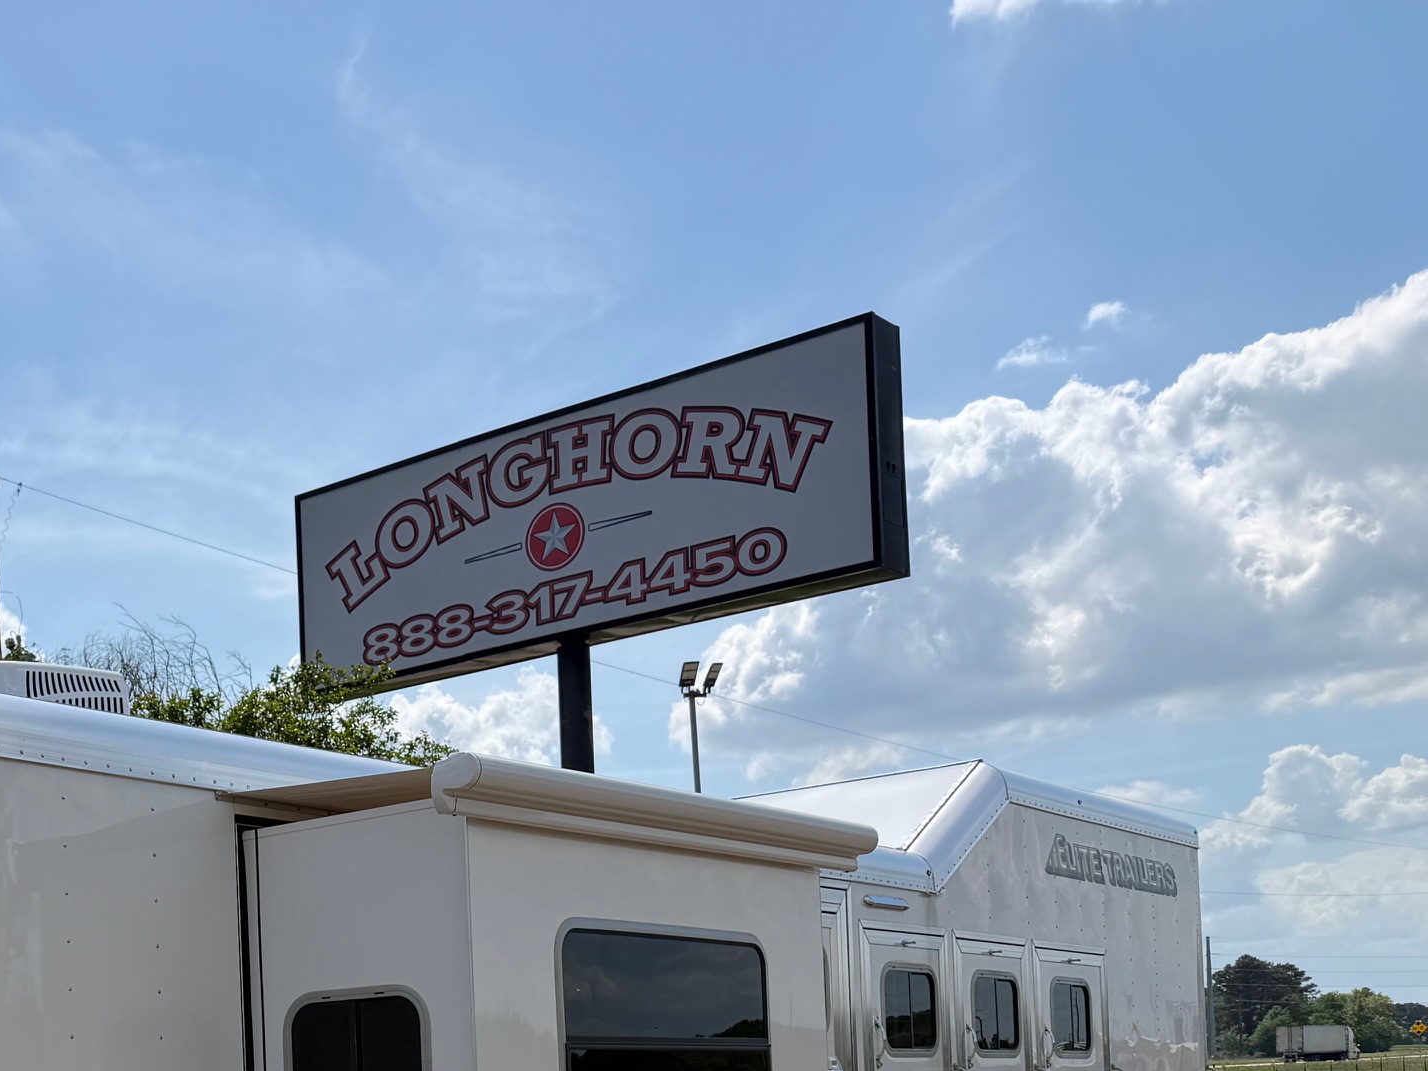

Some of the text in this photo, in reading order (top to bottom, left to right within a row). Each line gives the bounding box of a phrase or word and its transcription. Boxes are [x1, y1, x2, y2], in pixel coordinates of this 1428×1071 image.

[326, 406, 833, 613] LONGHORN
[363, 526, 788, 666] 888-317-4450
[1045, 833, 1178, 897] ELITE TRAILERS
